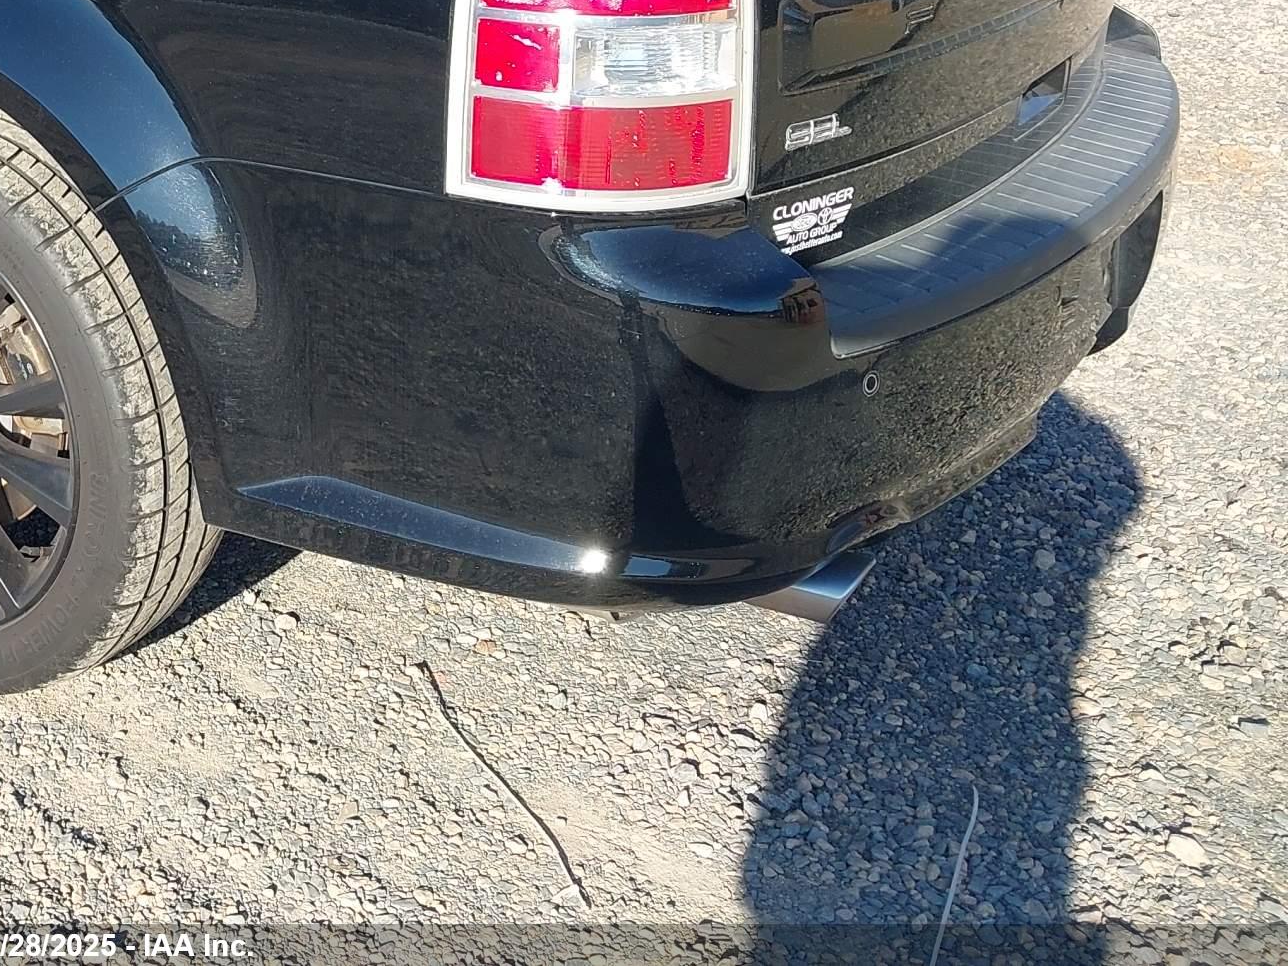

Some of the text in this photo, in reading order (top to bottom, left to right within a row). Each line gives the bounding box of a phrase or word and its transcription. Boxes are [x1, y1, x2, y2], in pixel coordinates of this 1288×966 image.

[785, 113, 853, 151] SEL
[772, 187, 855, 221] CLONINGER
[786, 231, 809, 245] AUTO
[809, 222, 838, 239] GROUP
